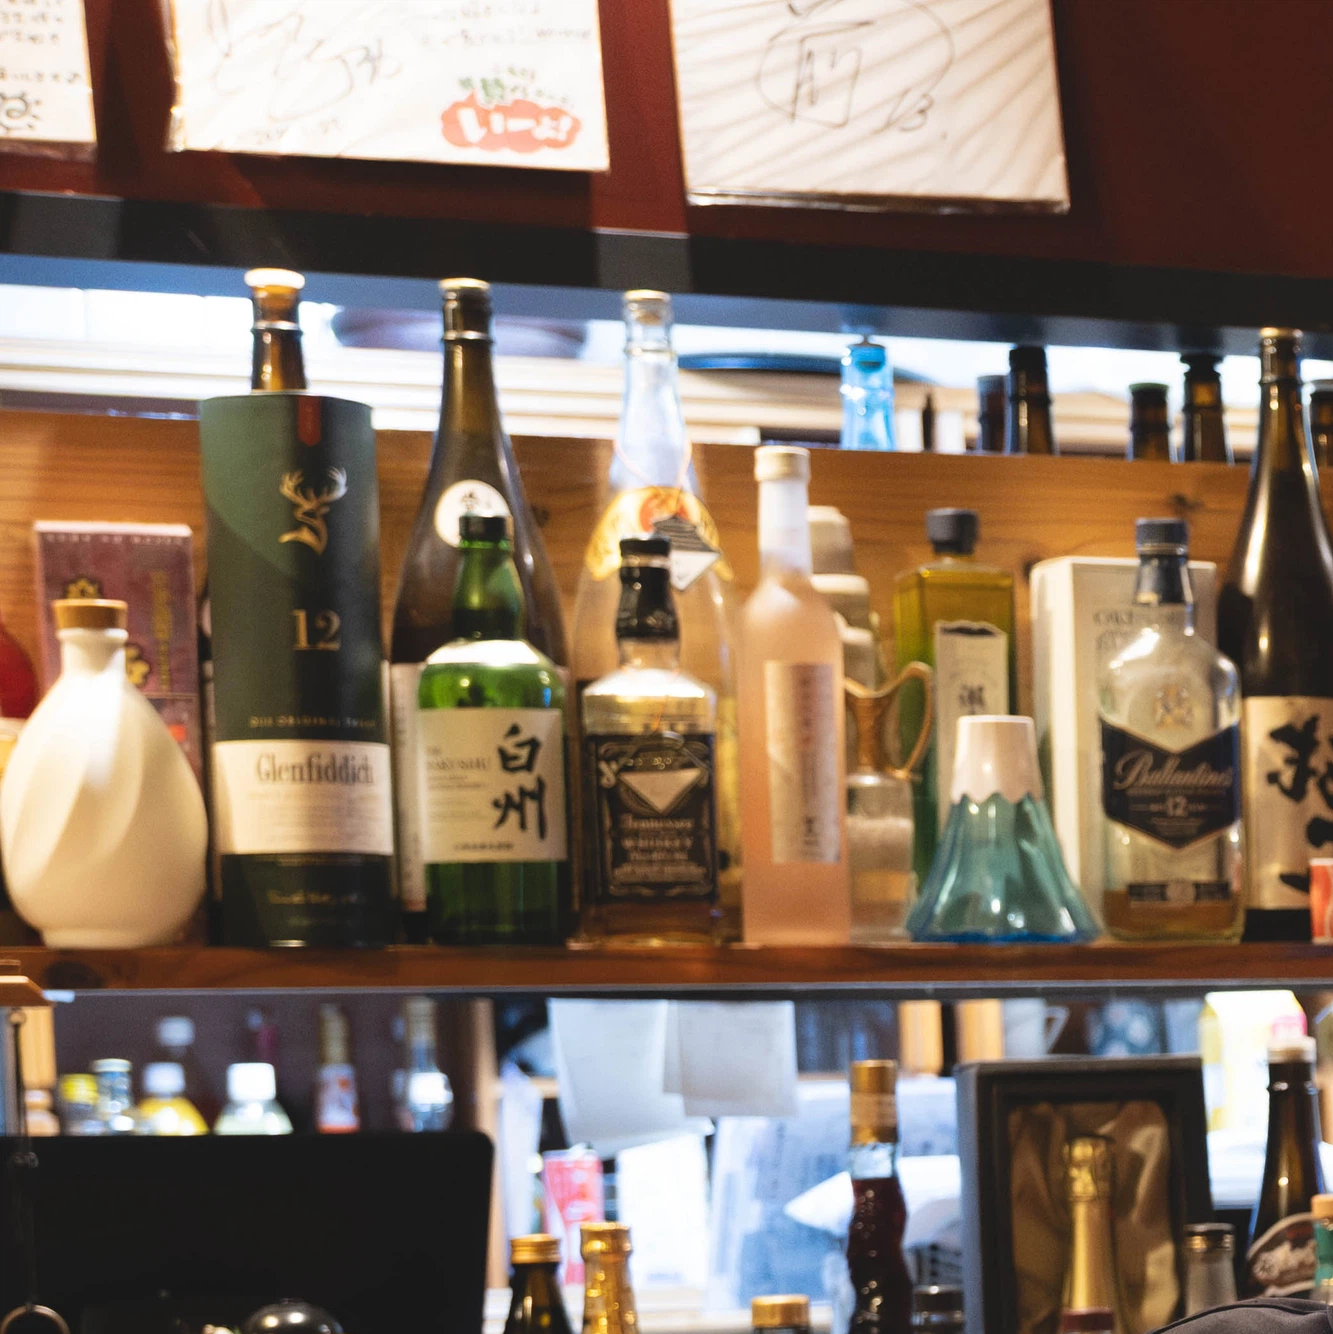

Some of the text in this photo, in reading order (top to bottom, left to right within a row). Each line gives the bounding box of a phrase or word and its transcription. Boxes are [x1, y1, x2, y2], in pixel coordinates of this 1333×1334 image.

[291, 608, 342, 651] 12
[256, 753, 374, 786] Glenfiddich
[491, 723, 546, 840] 白州
